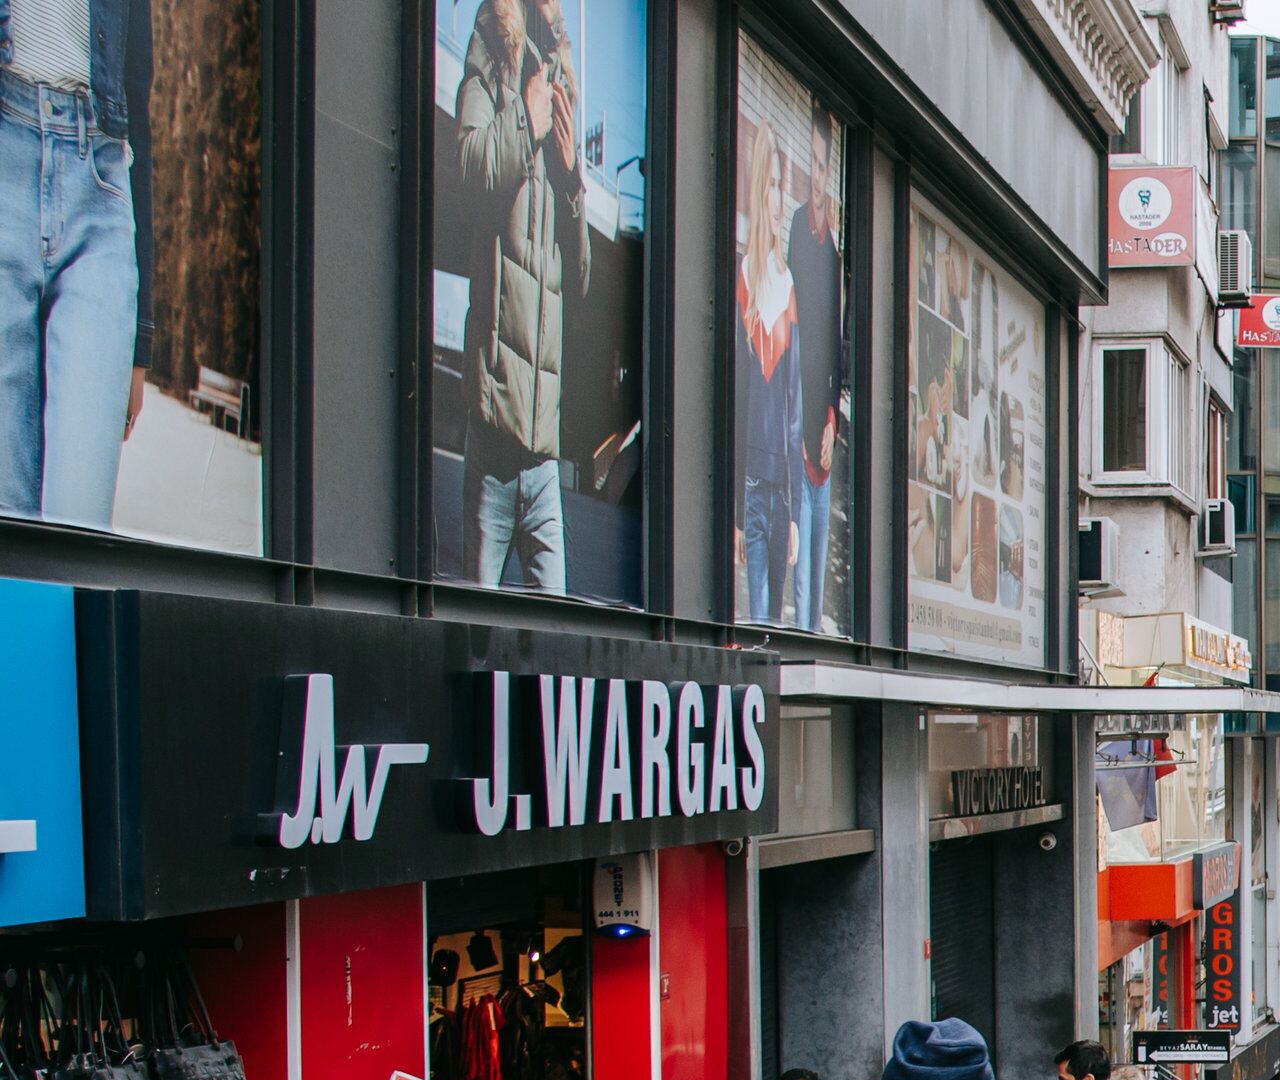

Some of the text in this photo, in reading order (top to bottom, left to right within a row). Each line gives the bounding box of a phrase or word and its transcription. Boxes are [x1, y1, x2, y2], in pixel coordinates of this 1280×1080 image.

[474, 670, 766, 837] J.WARGAS
[956, 764, 1047, 816] VICTORY HOTEL
[1212, 902, 1234, 1002] GROS
[1208, 1004, 1239, 1029] jet
[1180, 1043, 1208, 1051] SARAY
